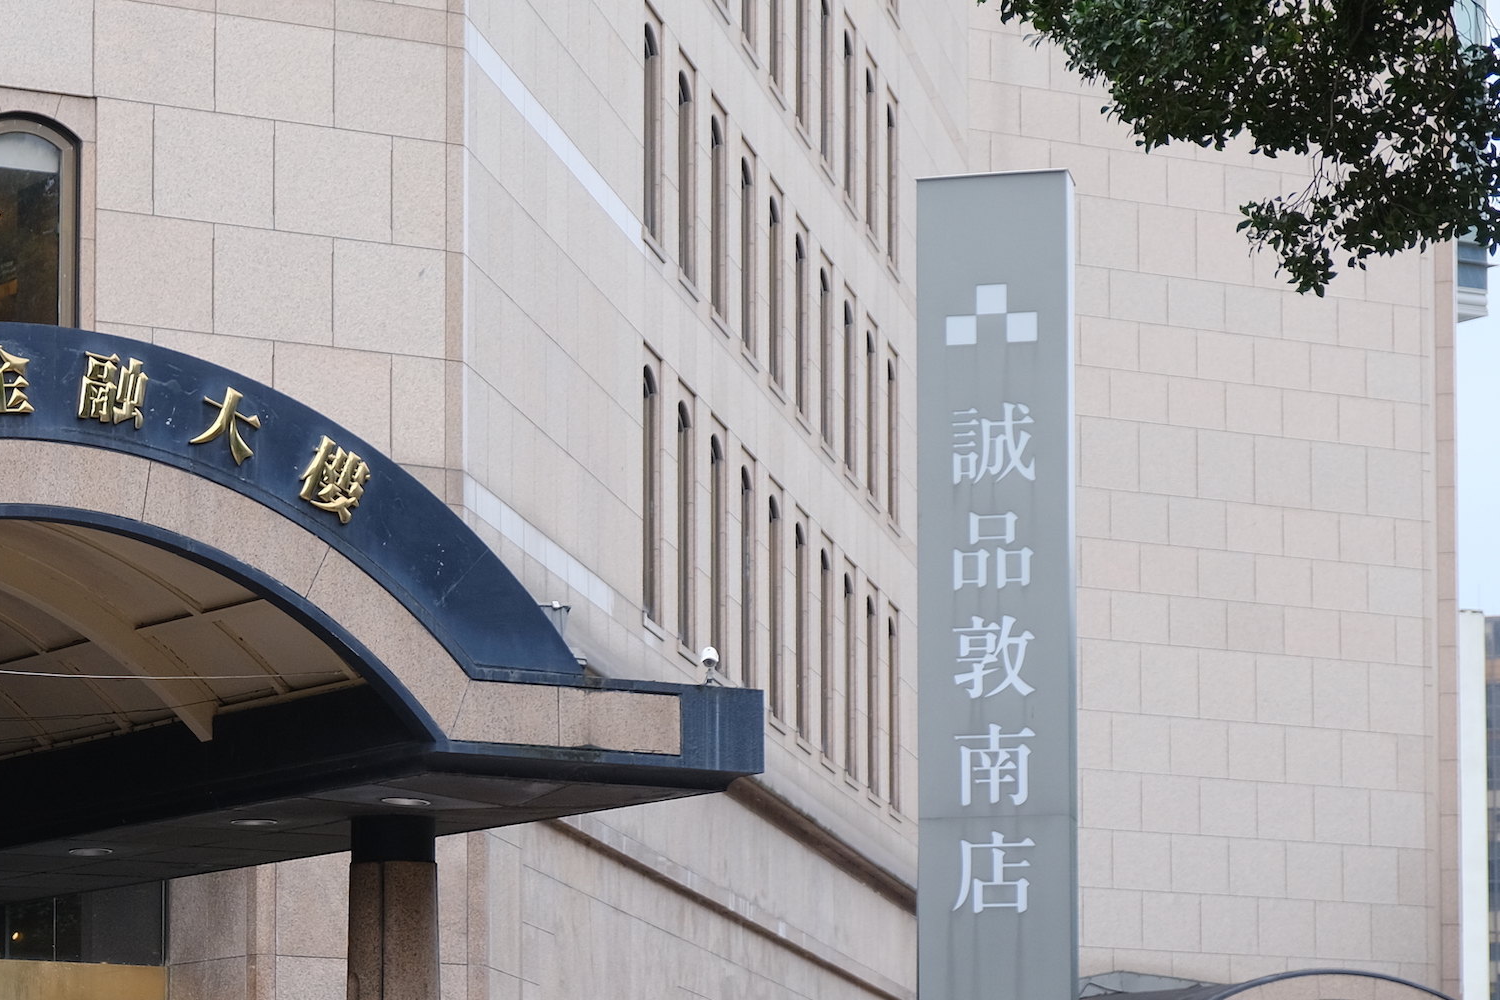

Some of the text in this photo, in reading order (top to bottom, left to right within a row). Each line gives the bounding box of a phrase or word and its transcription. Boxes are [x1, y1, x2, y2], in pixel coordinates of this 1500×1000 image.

[952, 402, 1037, 914] 誠品敦南店
